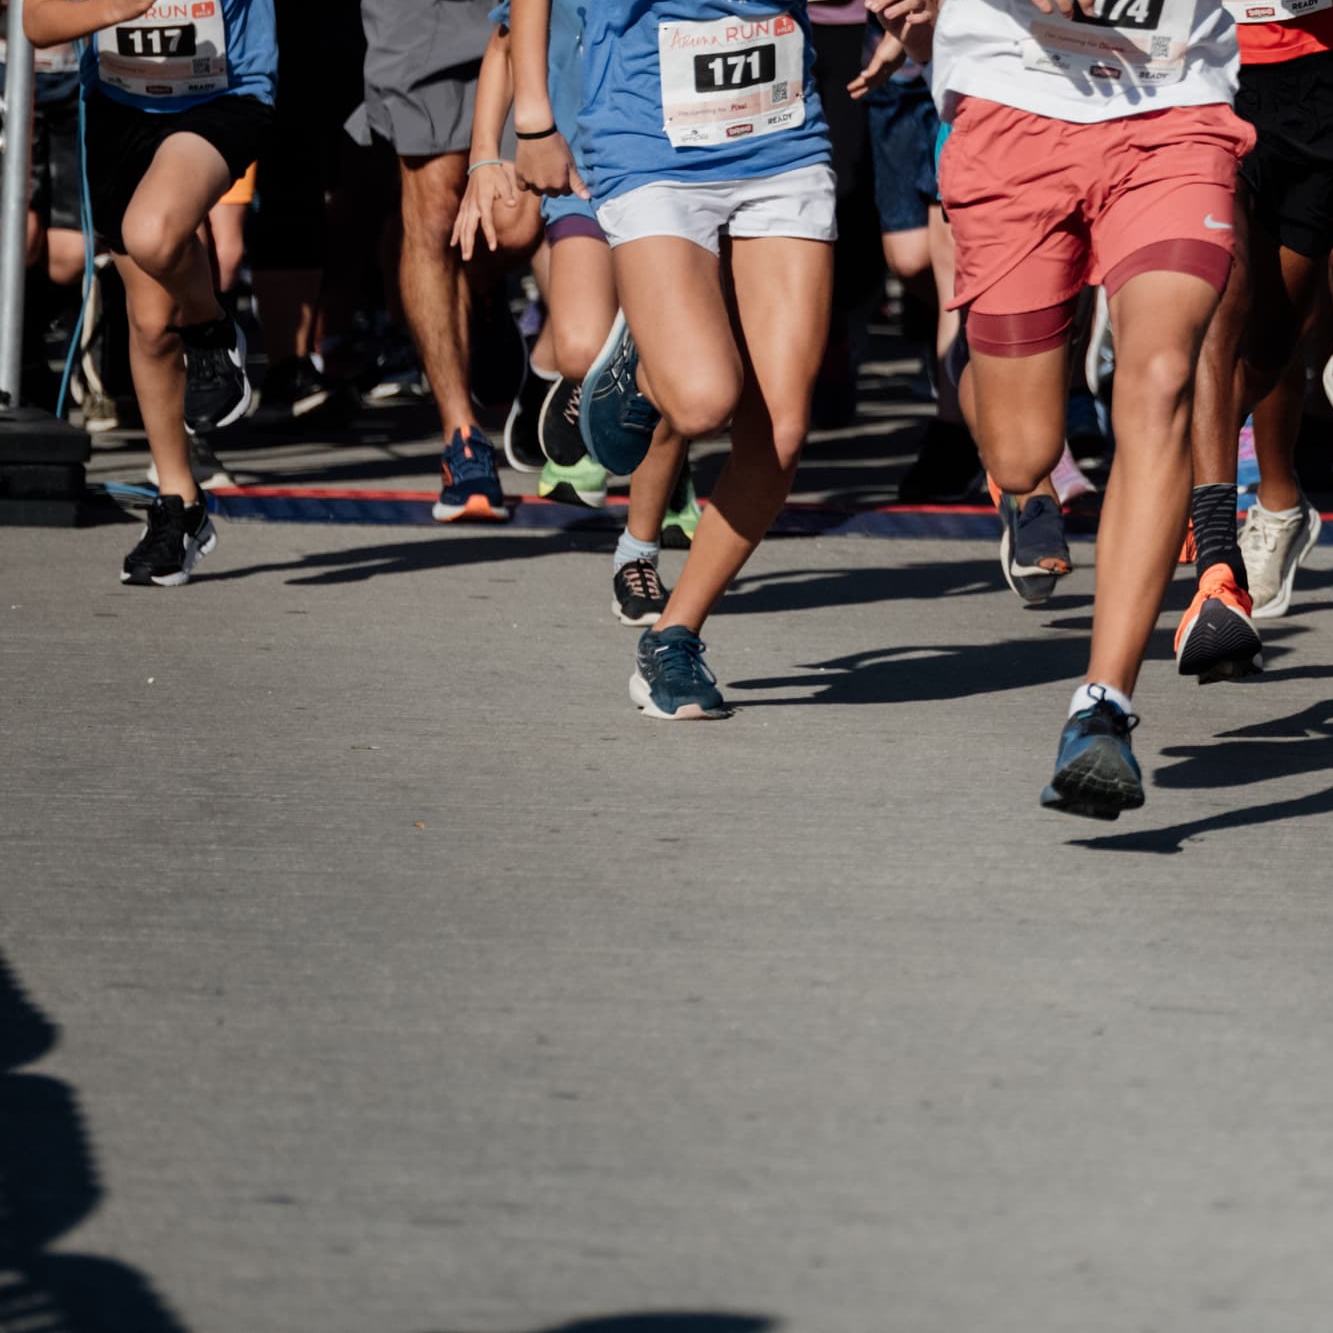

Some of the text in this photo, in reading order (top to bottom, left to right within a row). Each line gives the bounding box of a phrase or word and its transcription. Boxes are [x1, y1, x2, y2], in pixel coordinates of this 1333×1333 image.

[145, 4, 188, 19] RUN
[128, 29, 182, 53] 117
[725, 20, 769, 43] RUN
[708, 50, 760, 86] 171
[767, 113, 793, 125] READY
